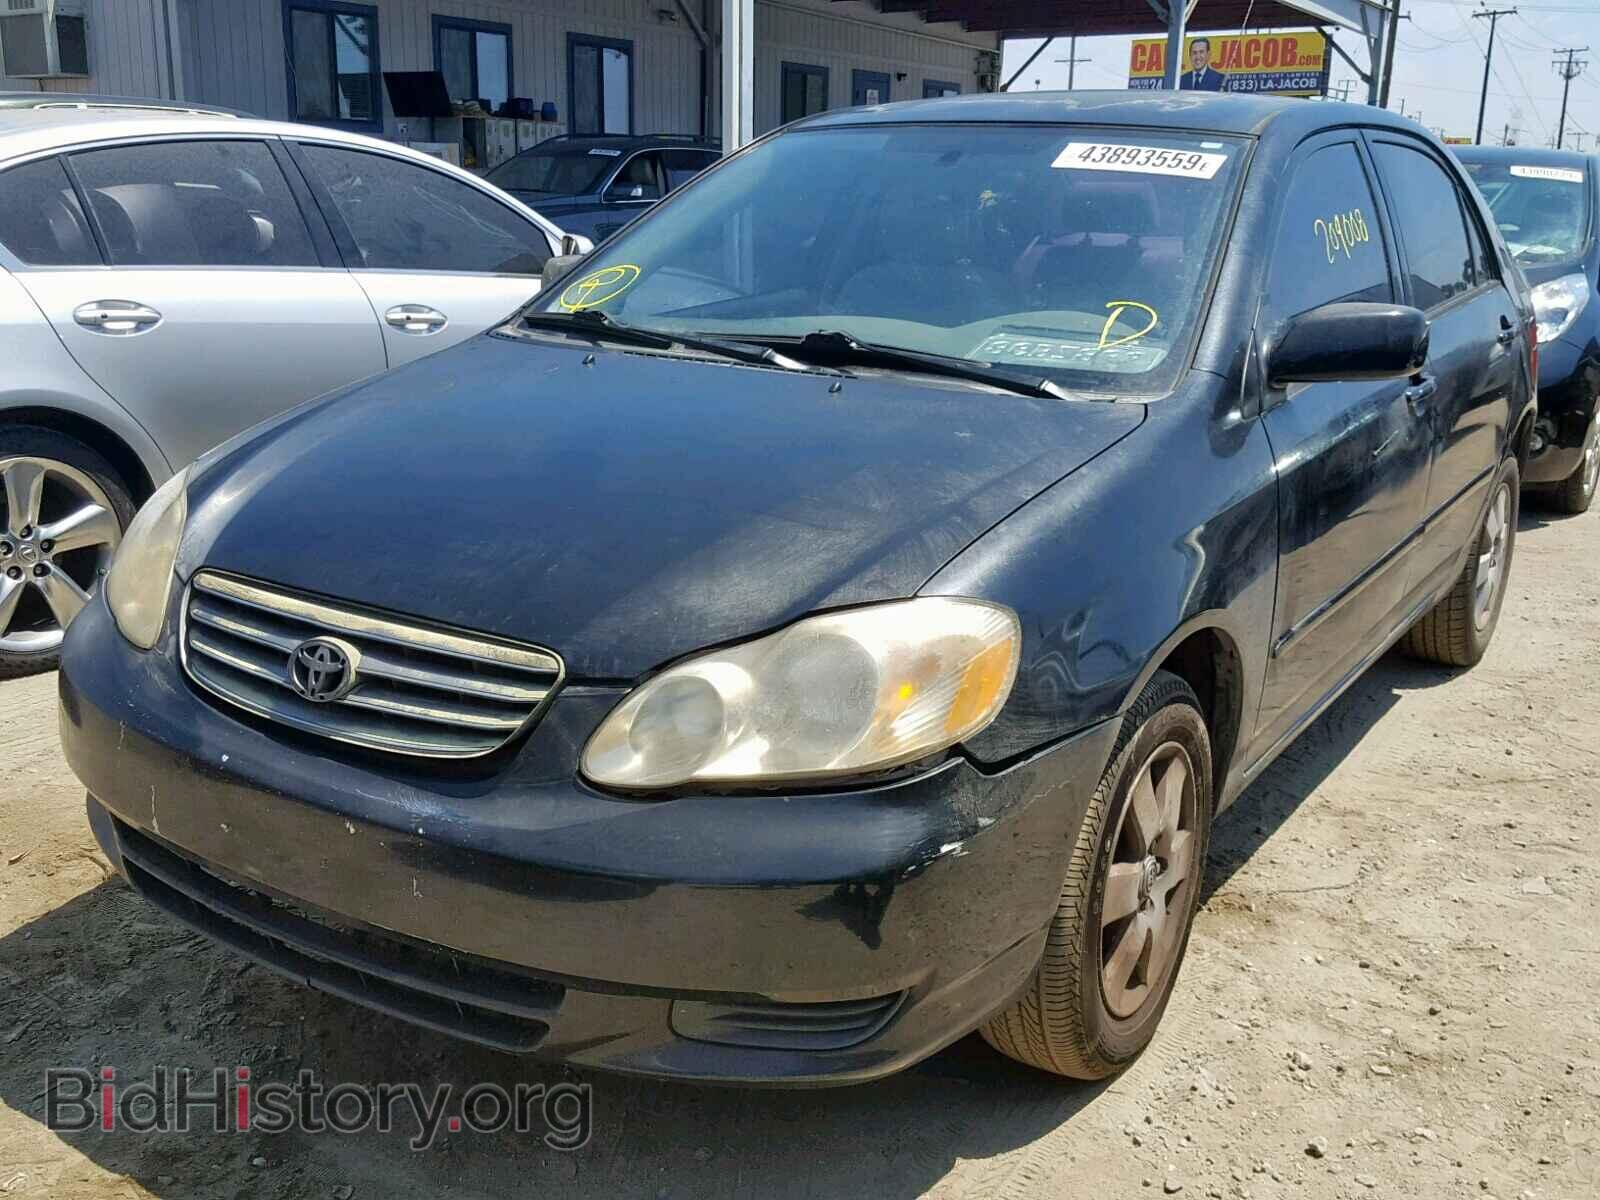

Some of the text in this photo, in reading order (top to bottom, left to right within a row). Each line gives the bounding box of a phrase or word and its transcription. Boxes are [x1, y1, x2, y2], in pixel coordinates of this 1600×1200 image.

[1228, 78, 1318, 92] (833) LA-JACOB
[1077, 145, 1203, 171] 43893559
